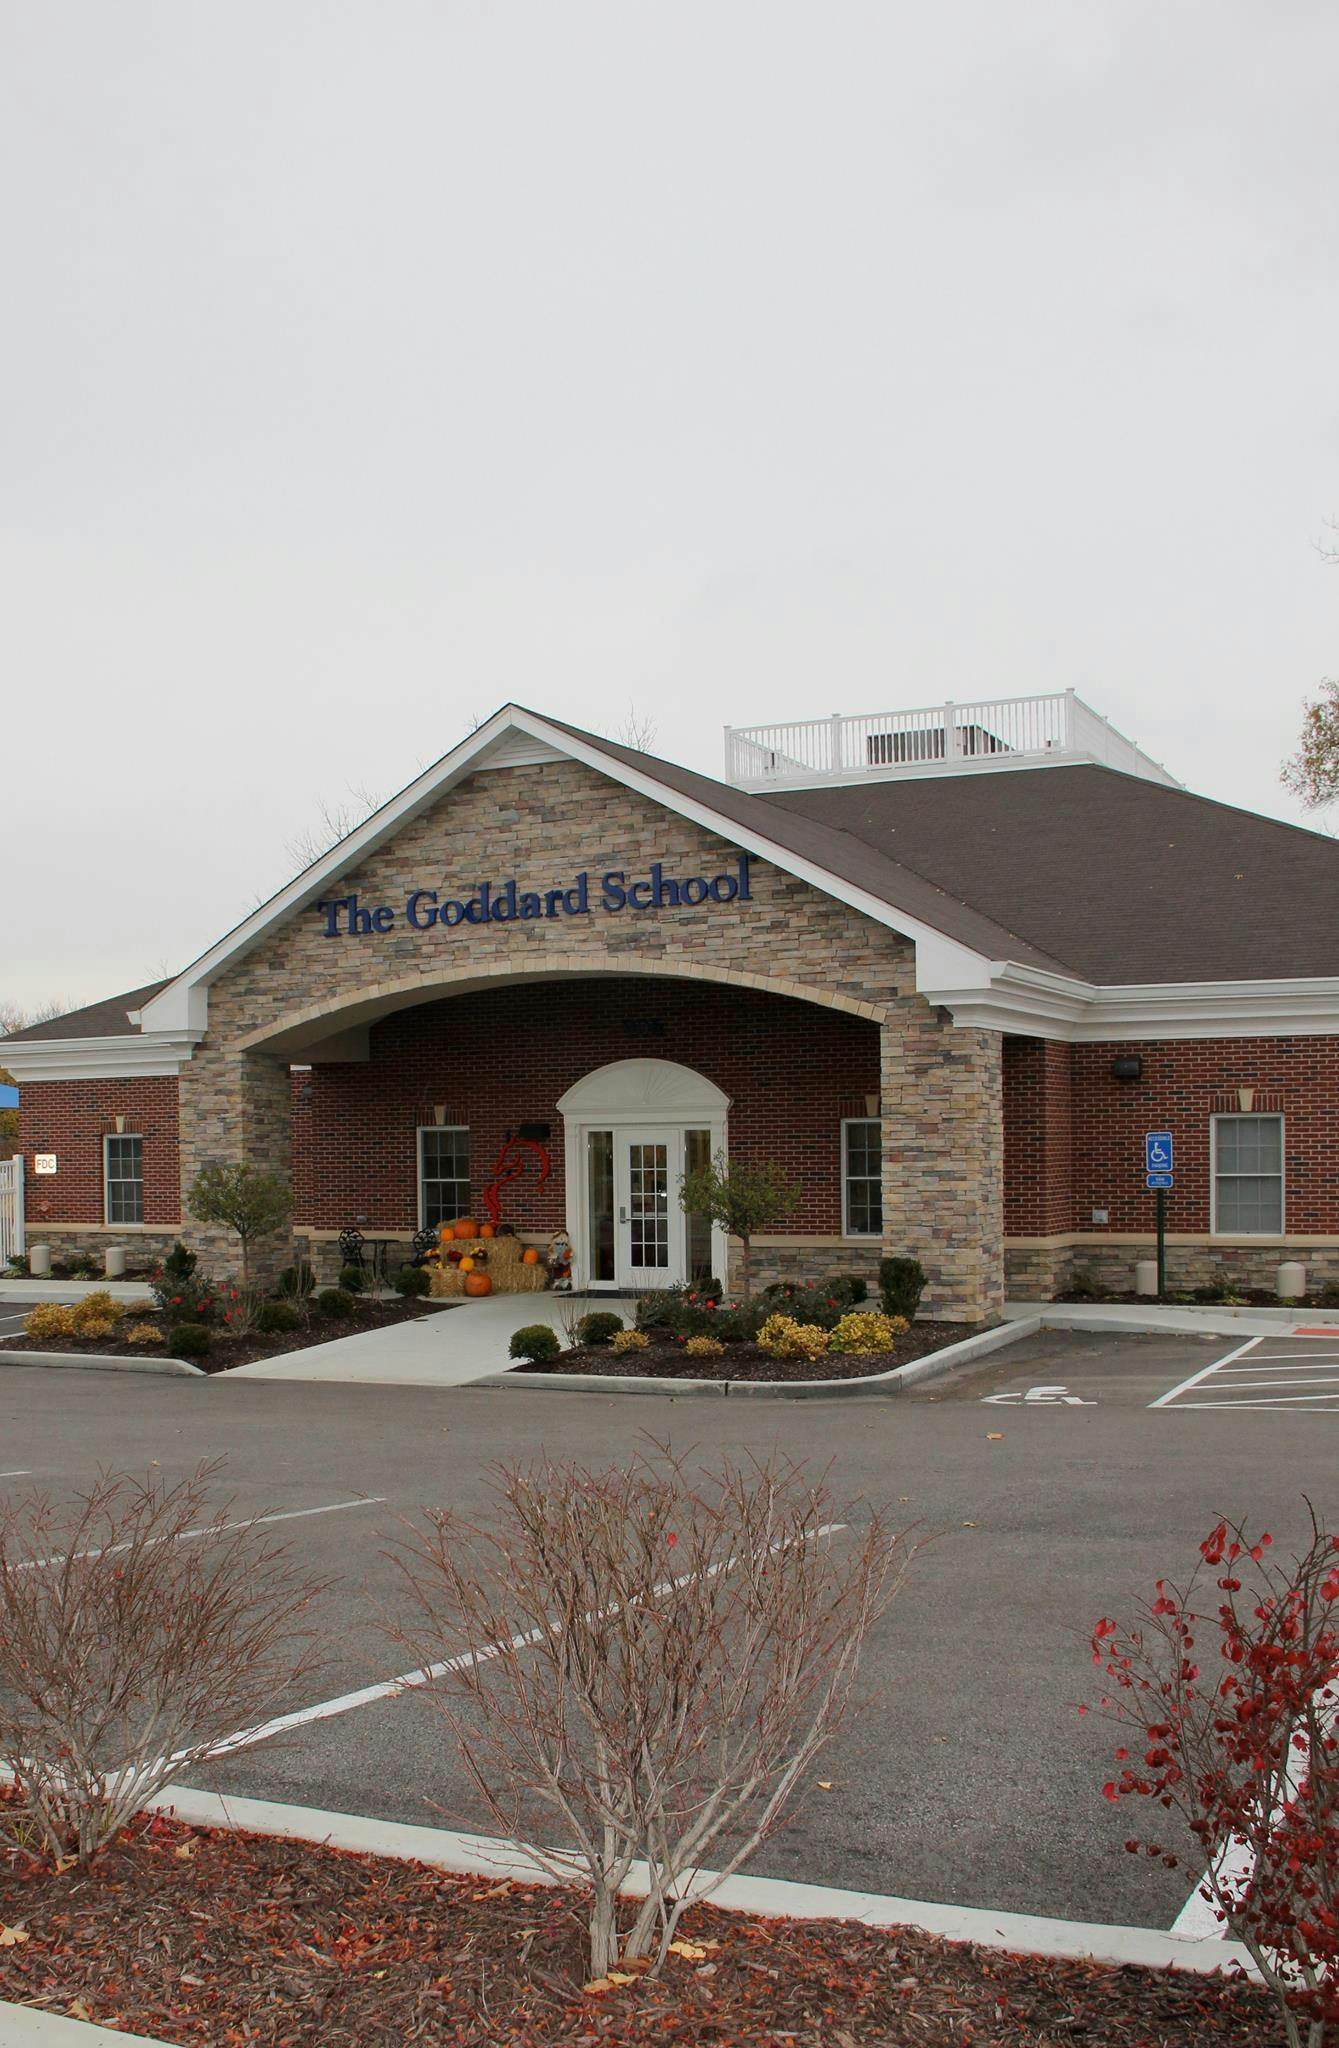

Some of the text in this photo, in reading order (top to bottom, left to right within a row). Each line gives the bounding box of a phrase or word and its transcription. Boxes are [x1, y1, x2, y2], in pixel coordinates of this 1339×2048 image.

[318, 855, 753, 937] The Goddard School
[37, 1158, 55, 1169] FDC
